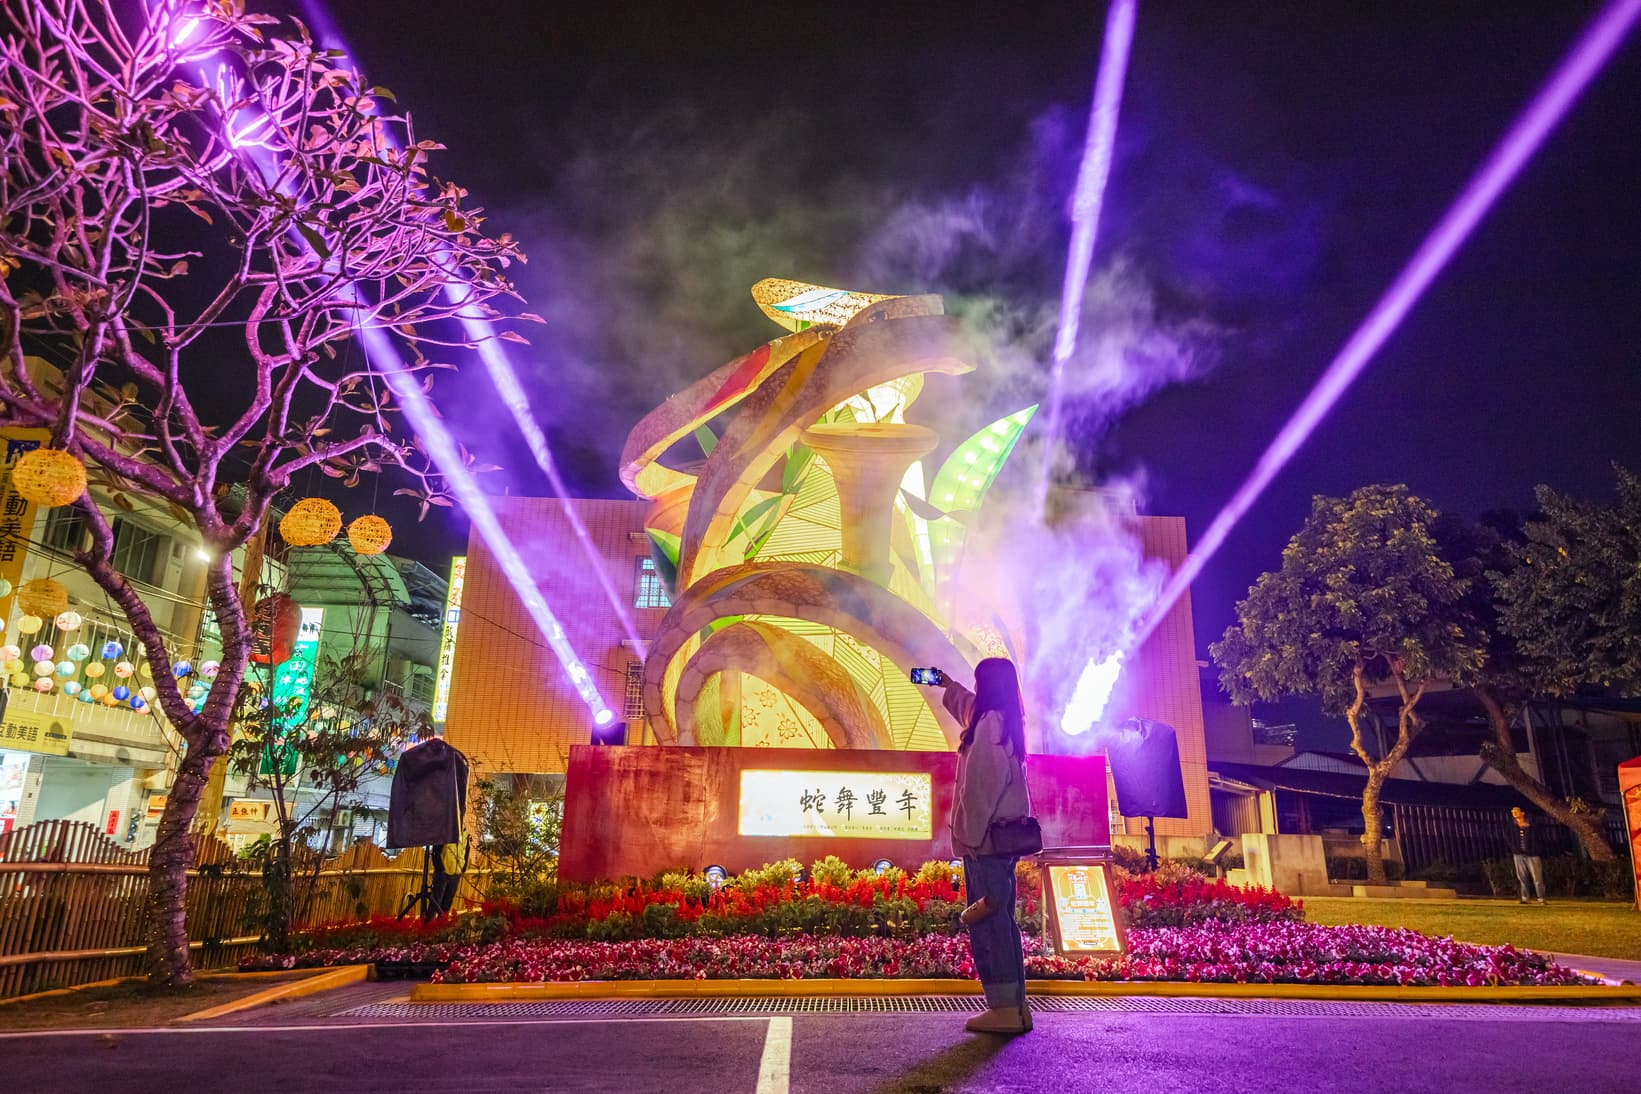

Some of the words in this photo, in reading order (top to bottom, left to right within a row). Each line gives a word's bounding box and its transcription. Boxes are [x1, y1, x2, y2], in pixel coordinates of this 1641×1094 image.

[0, 489, 28, 562] 動美語
[800, 786, 918, 821] 蛇舞豐年
